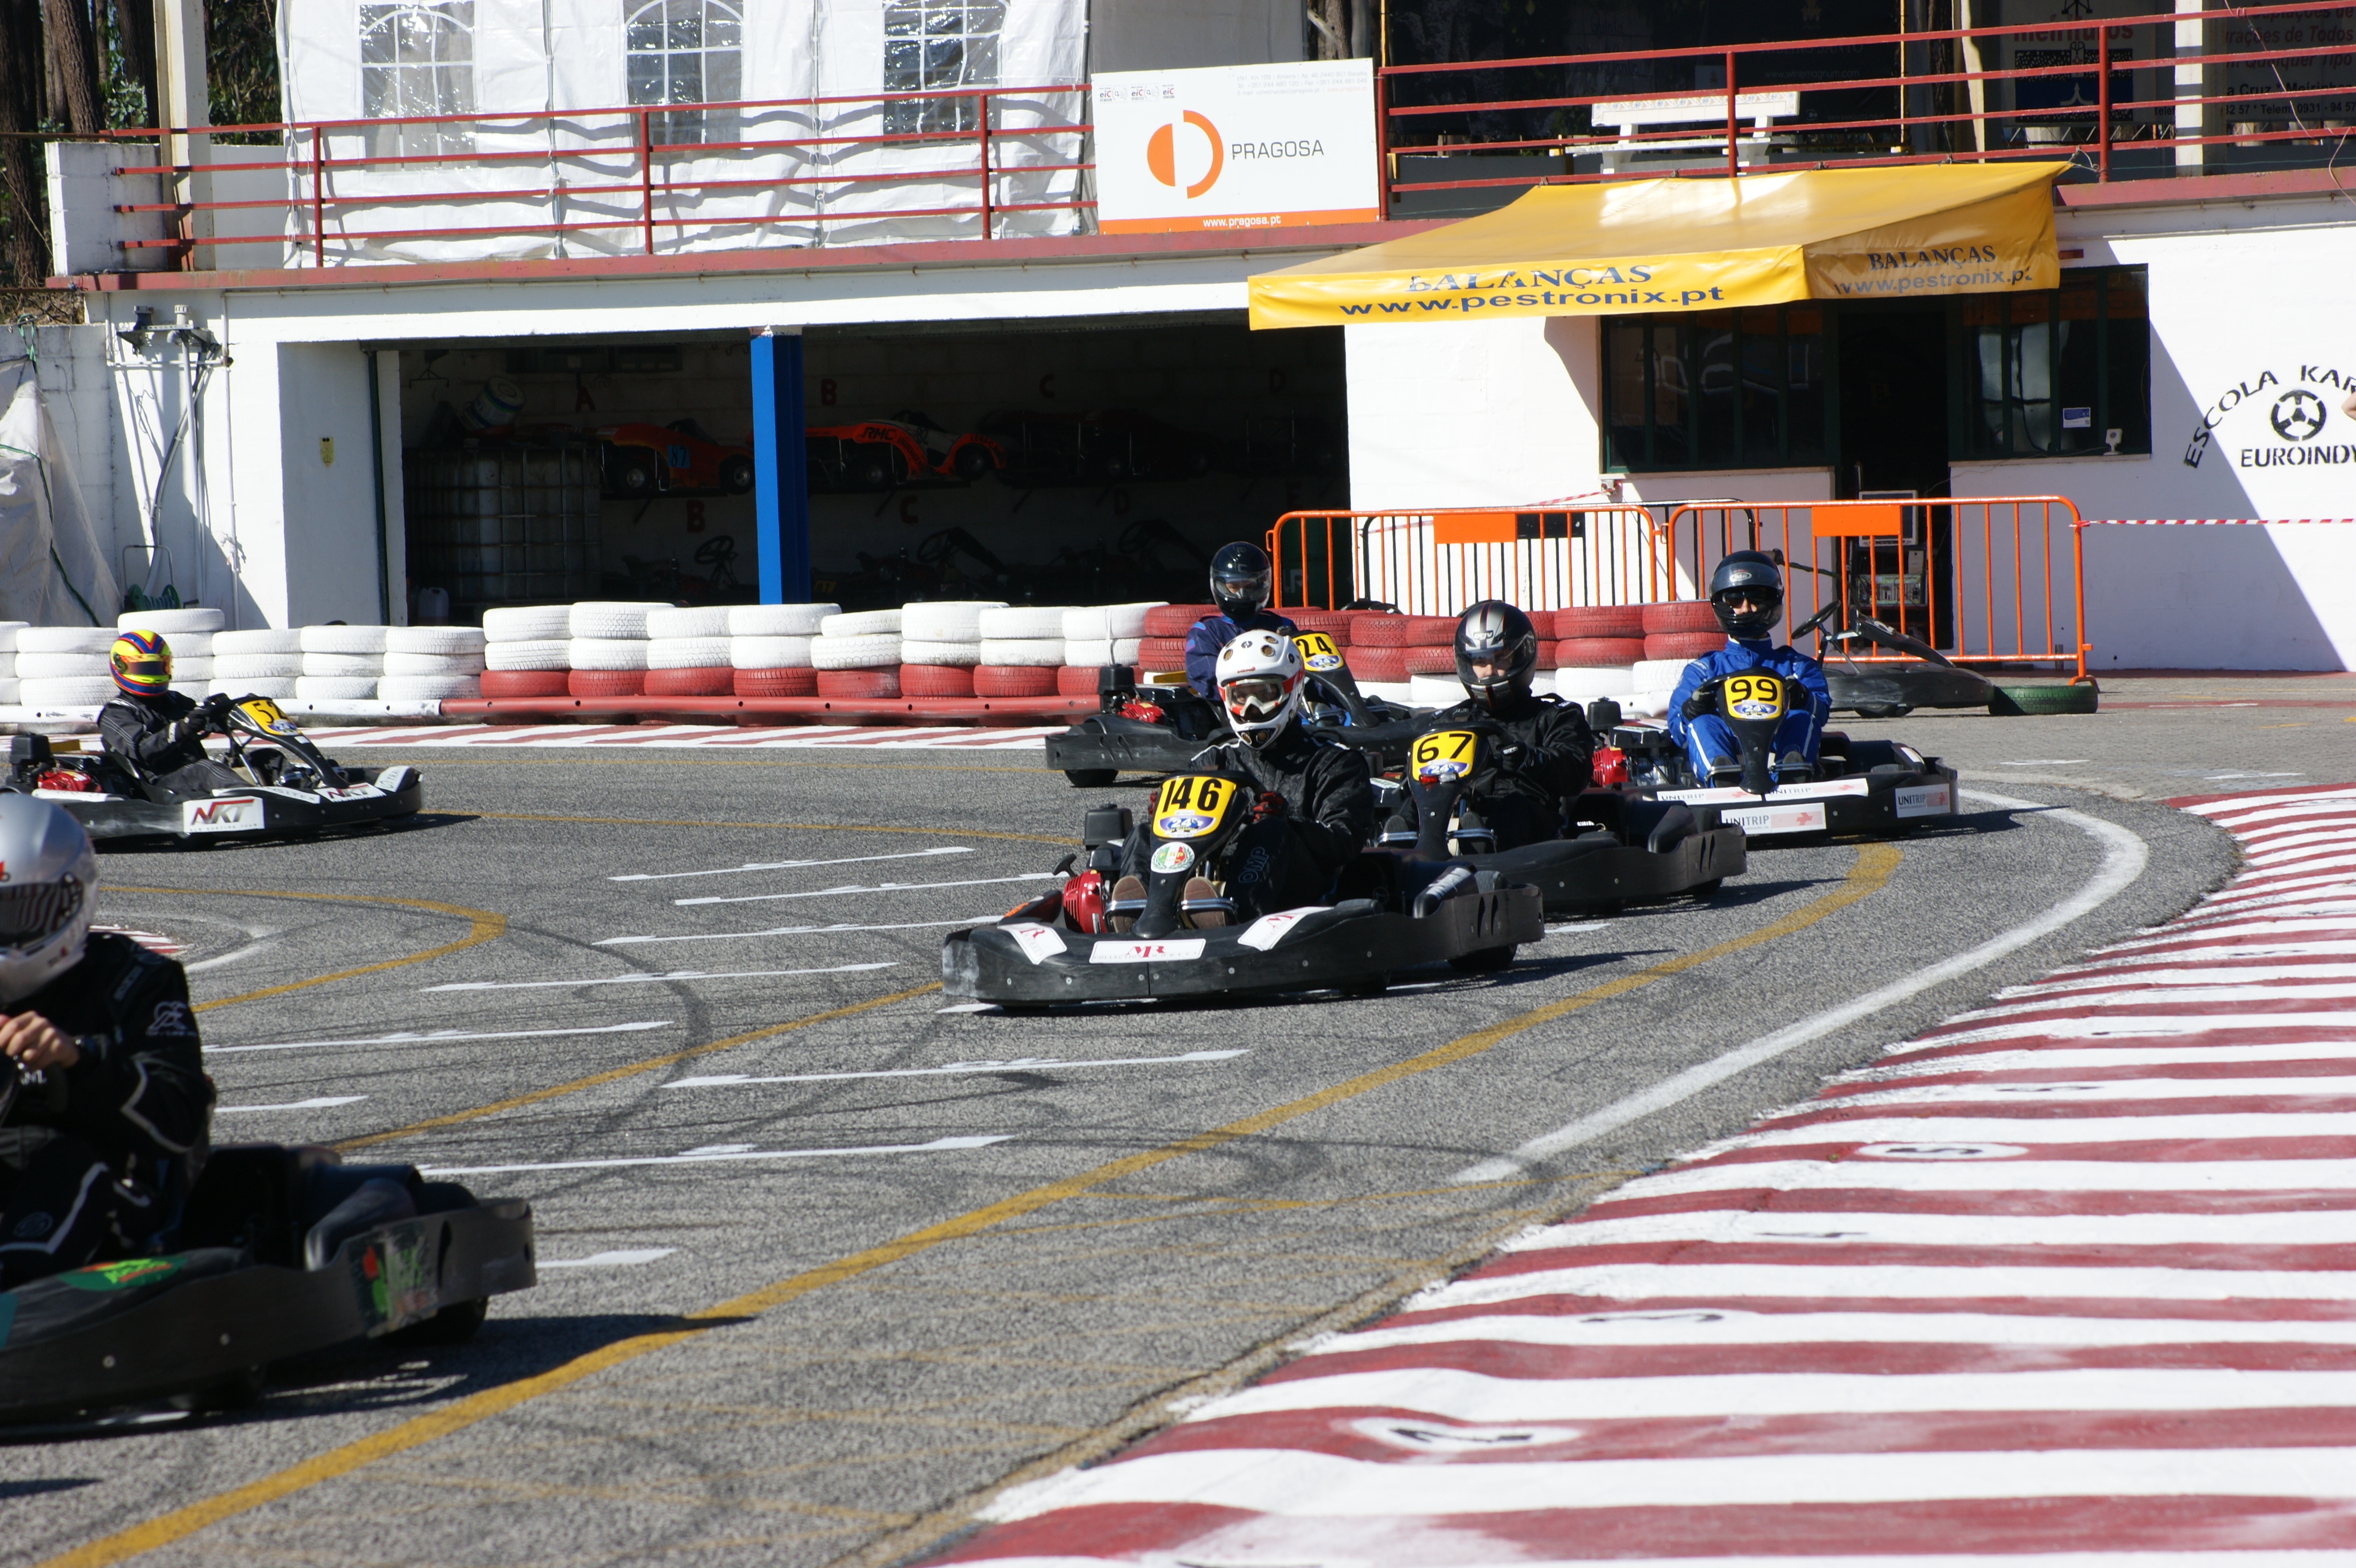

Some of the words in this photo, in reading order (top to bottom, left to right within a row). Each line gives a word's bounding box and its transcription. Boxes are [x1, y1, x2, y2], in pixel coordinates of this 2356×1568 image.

[2285, 27, 2303, 43] de
[2309, 26, 2354, 43] Todos
[2239, 83, 2272, 95] Cruz
[2239, 105, 2250, 114] 57
[2297, 103, 2321, 113] 0931
[2330, 102, 2342, 112] 94
[1232, 140, 1325, 160] PRAGOSA
[1202, 214, 1281, 229] www.pragosa.pt
[1867, 245, 1997, 271] BALANÇAS
[1340, 285, 1724, 316] www.pestronix.pt
[821, 378, 837, 405] B
[1039, 374, 1055, 399] C
[2183, 369, 2280, 469] ESCOLA
[670, 446, 689, 468] 87
[686, 499, 705, 534] B
[900, 495, 918, 524] C
[1295, 636, 1333, 658] 24
[1731, 679, 1778, 704] 99
[253, 700, 289, 724] 52
[1417, 733, 1473, 763] 67
[1162, 777, 1222, 814] 146
[1898, 794, 1926, 806] UNITRIP
[190, 799, 255, 826] NKT
[1125, 946, 1165, 958] MR
